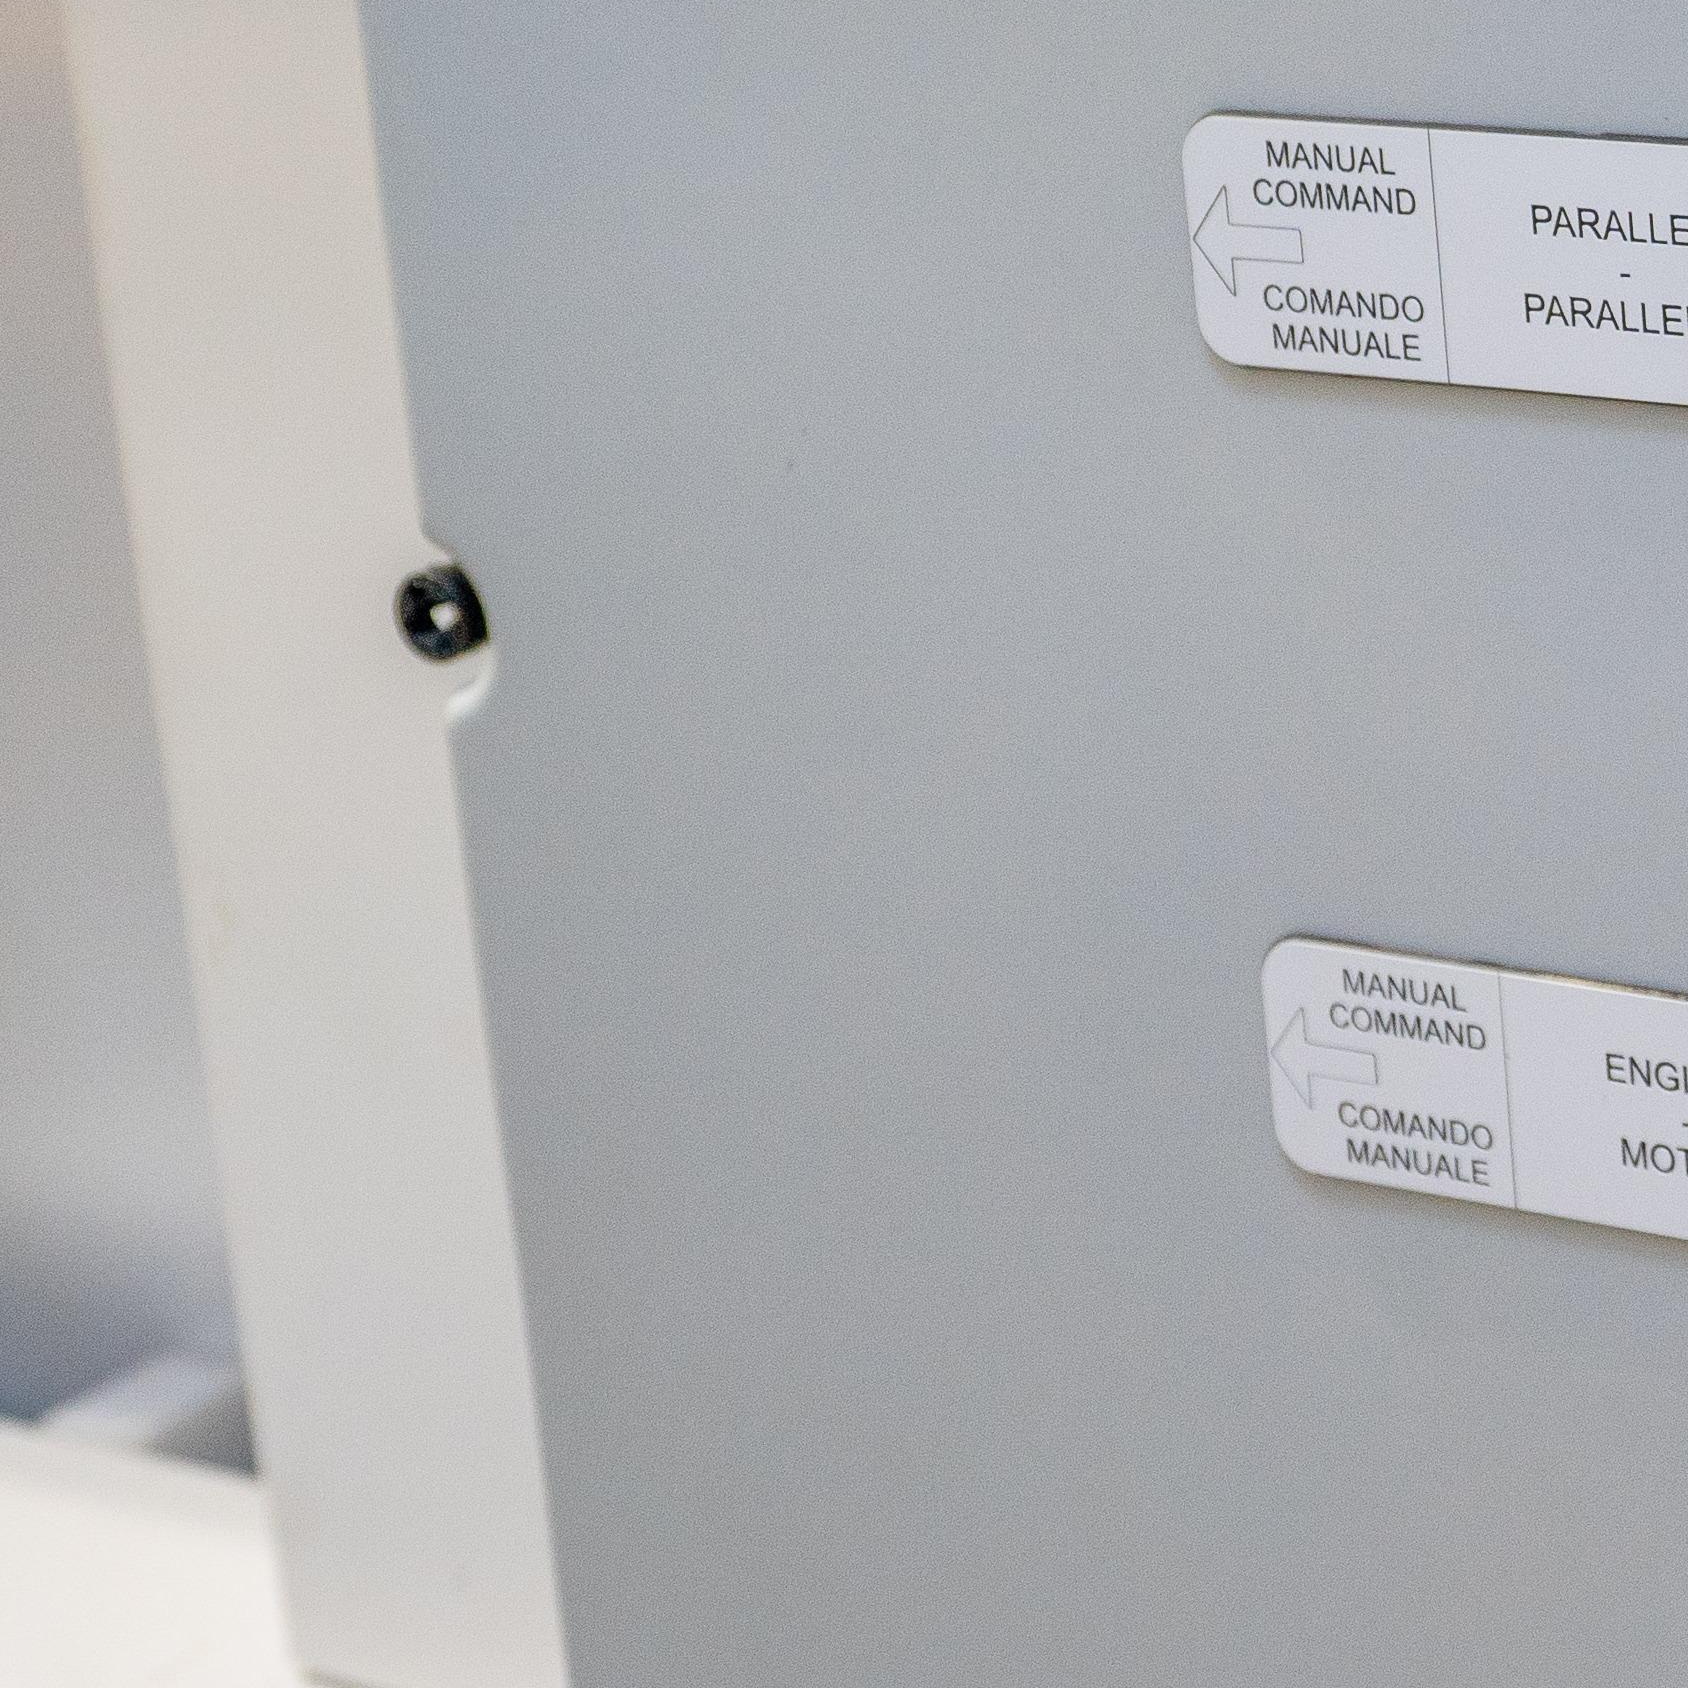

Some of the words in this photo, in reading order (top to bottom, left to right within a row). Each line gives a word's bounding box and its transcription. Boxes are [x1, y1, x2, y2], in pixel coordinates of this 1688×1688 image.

[1265, 139, 1397, 177] MANUAL
[1251, 177, 1417, 217] COMMAND
[1262, 283, 1426, 324] COMANDO
[1271, 322, 1422, 362] MANUALE
[1342, 968, 1467, 1013] MANUAL
[1328, 1002, 1487, 1051] COMMAND
[1337, 1100, 1494, 1151] COMANDO
[1346, 1137, 1489, 1187] MANUALE
